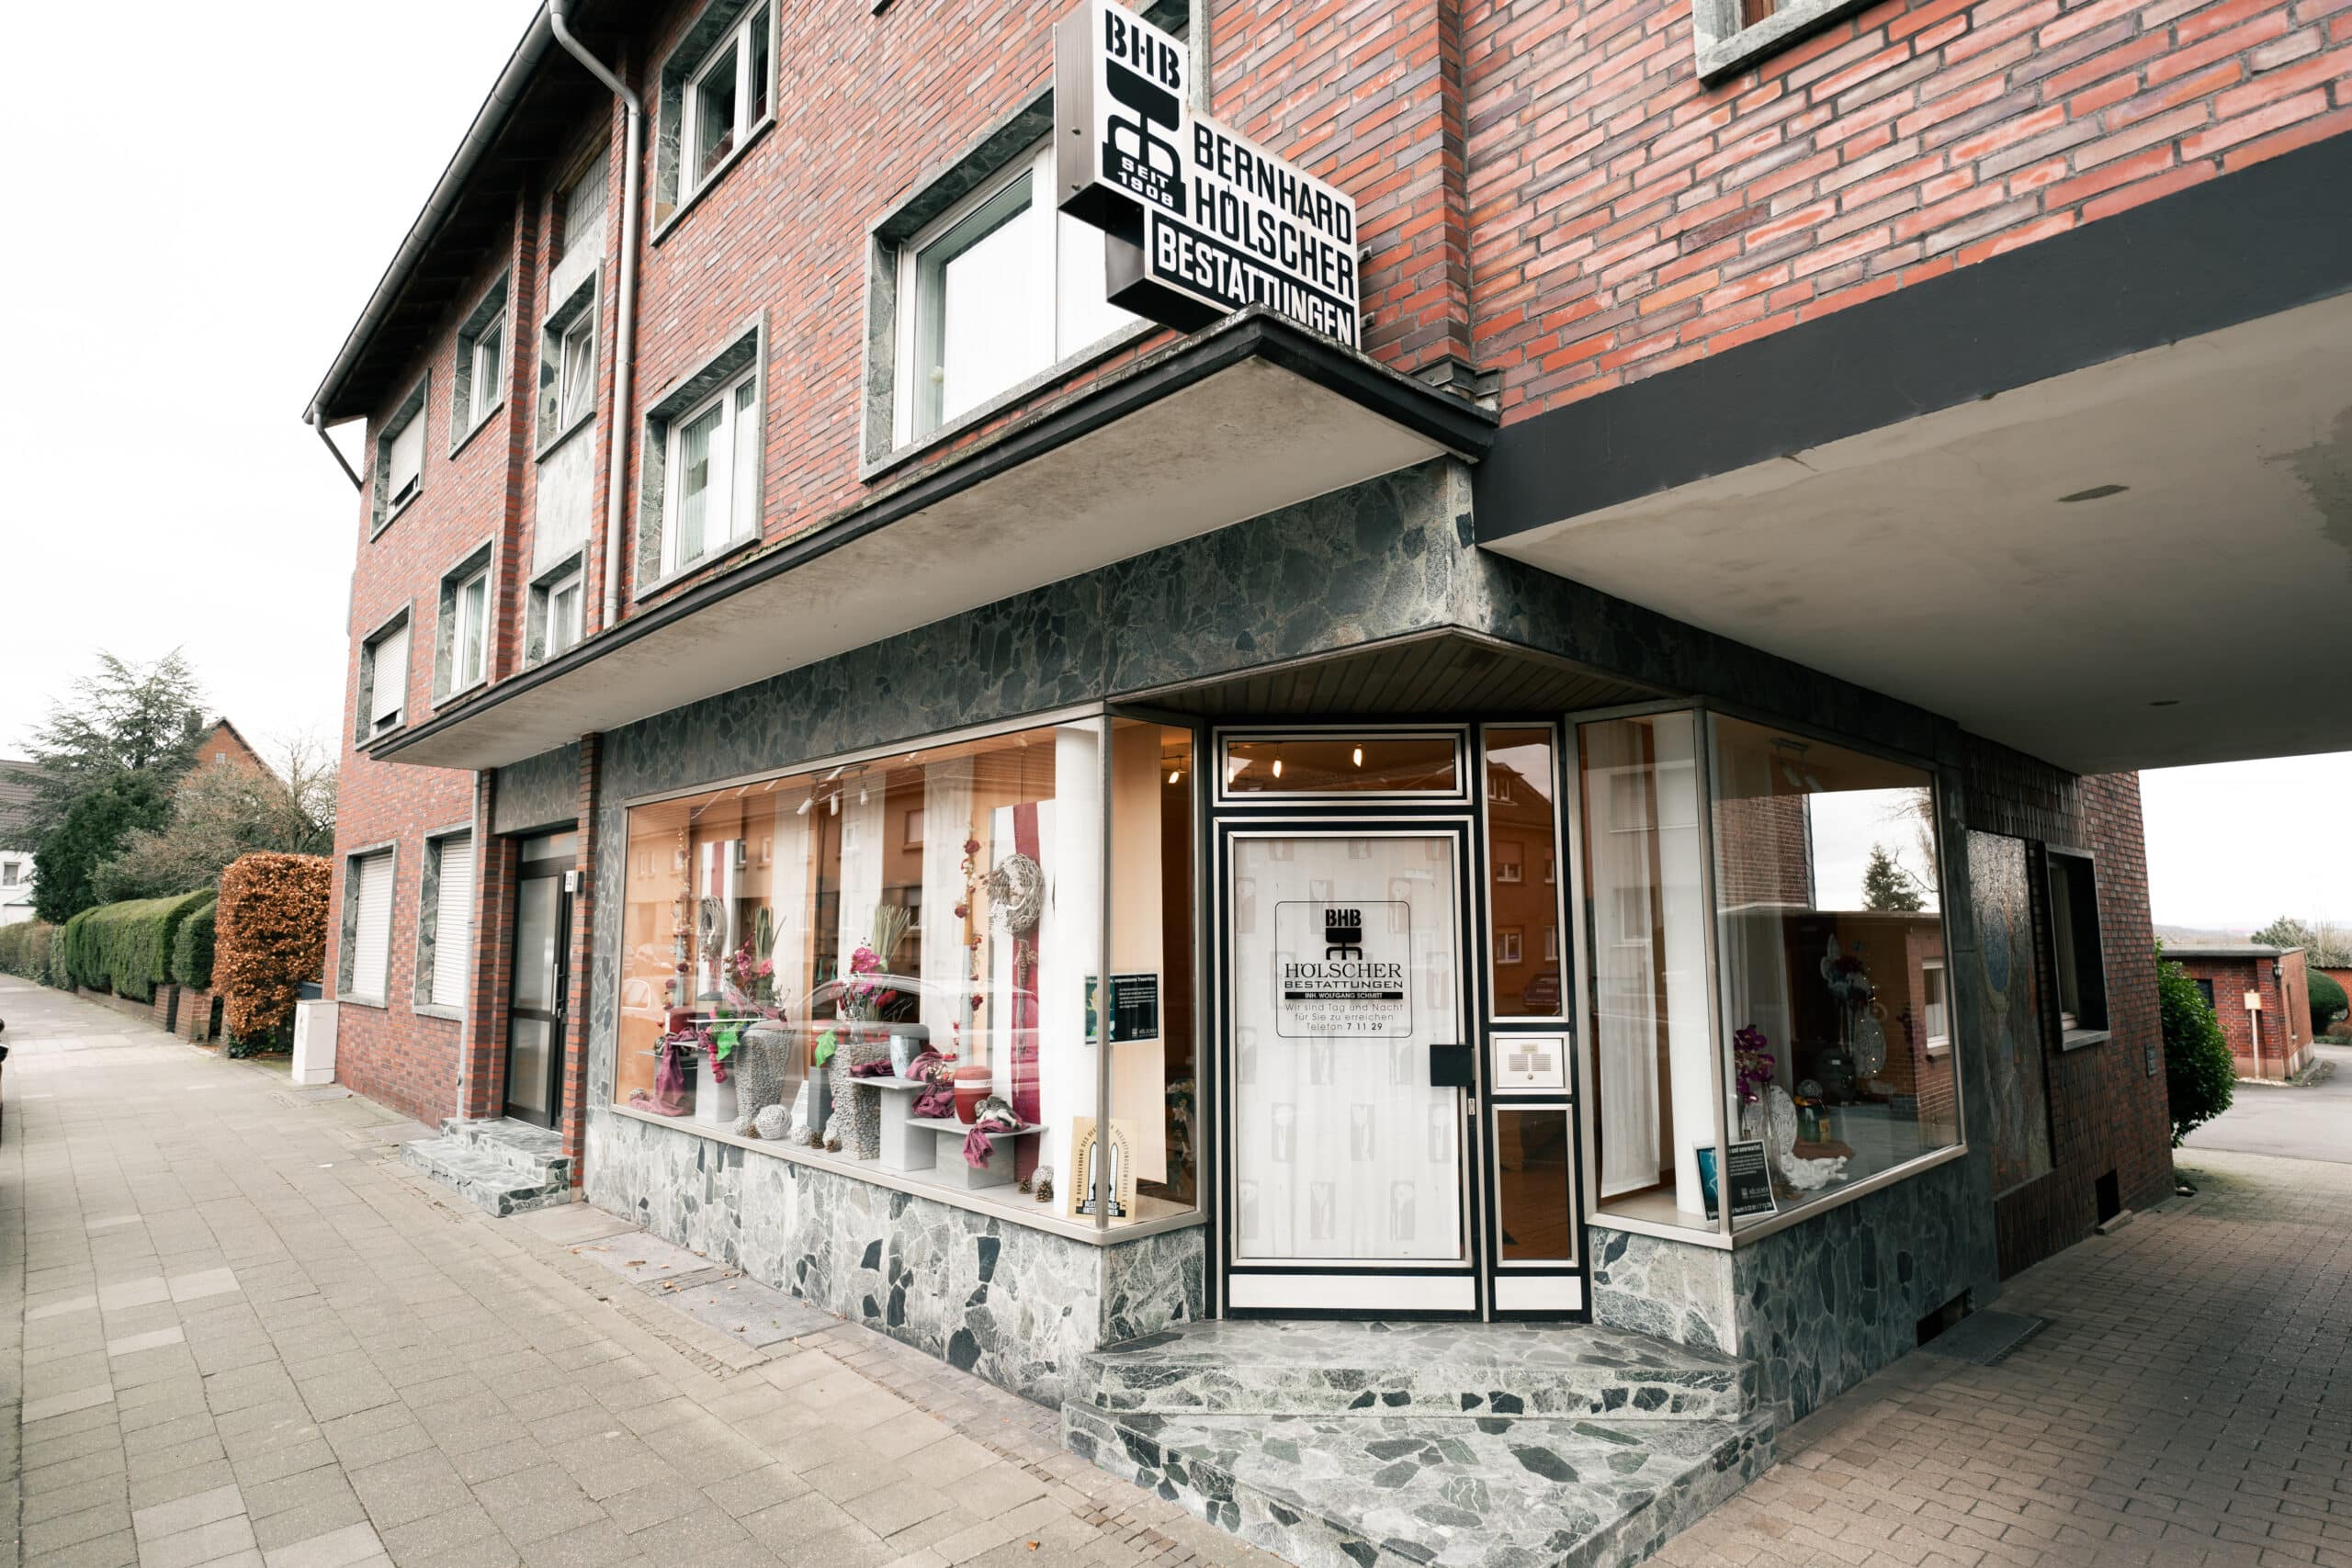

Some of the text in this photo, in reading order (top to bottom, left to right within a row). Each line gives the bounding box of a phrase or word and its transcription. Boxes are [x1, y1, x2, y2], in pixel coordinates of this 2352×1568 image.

[1105, 9, 1181, 90] BHB
[1121, 156, 1169, 188] SEIT
[1117, 171, 1173, 208] 1908
[1193, 120, 1352, 245] BERNHARD
[1158, 221, 1351, 347] BESTATTUNGEN
[1325, 908, 1362, 927] BHB
[1284, 963, 1403, 978] HÖLSCHER
[1284, 980, 1403, 988] BESTATTUNGEN
[1285, 1003, 1403, 1012] Wir sind Tag und Nacht
[1295, 1013, 1308, 1021] für
[1311, 1013, 1327, 1021] Sie
[1344, 1013, 1394, 1021] erreichen
[1306, 1022, 1383, 1031] Telefon 7 11 29
